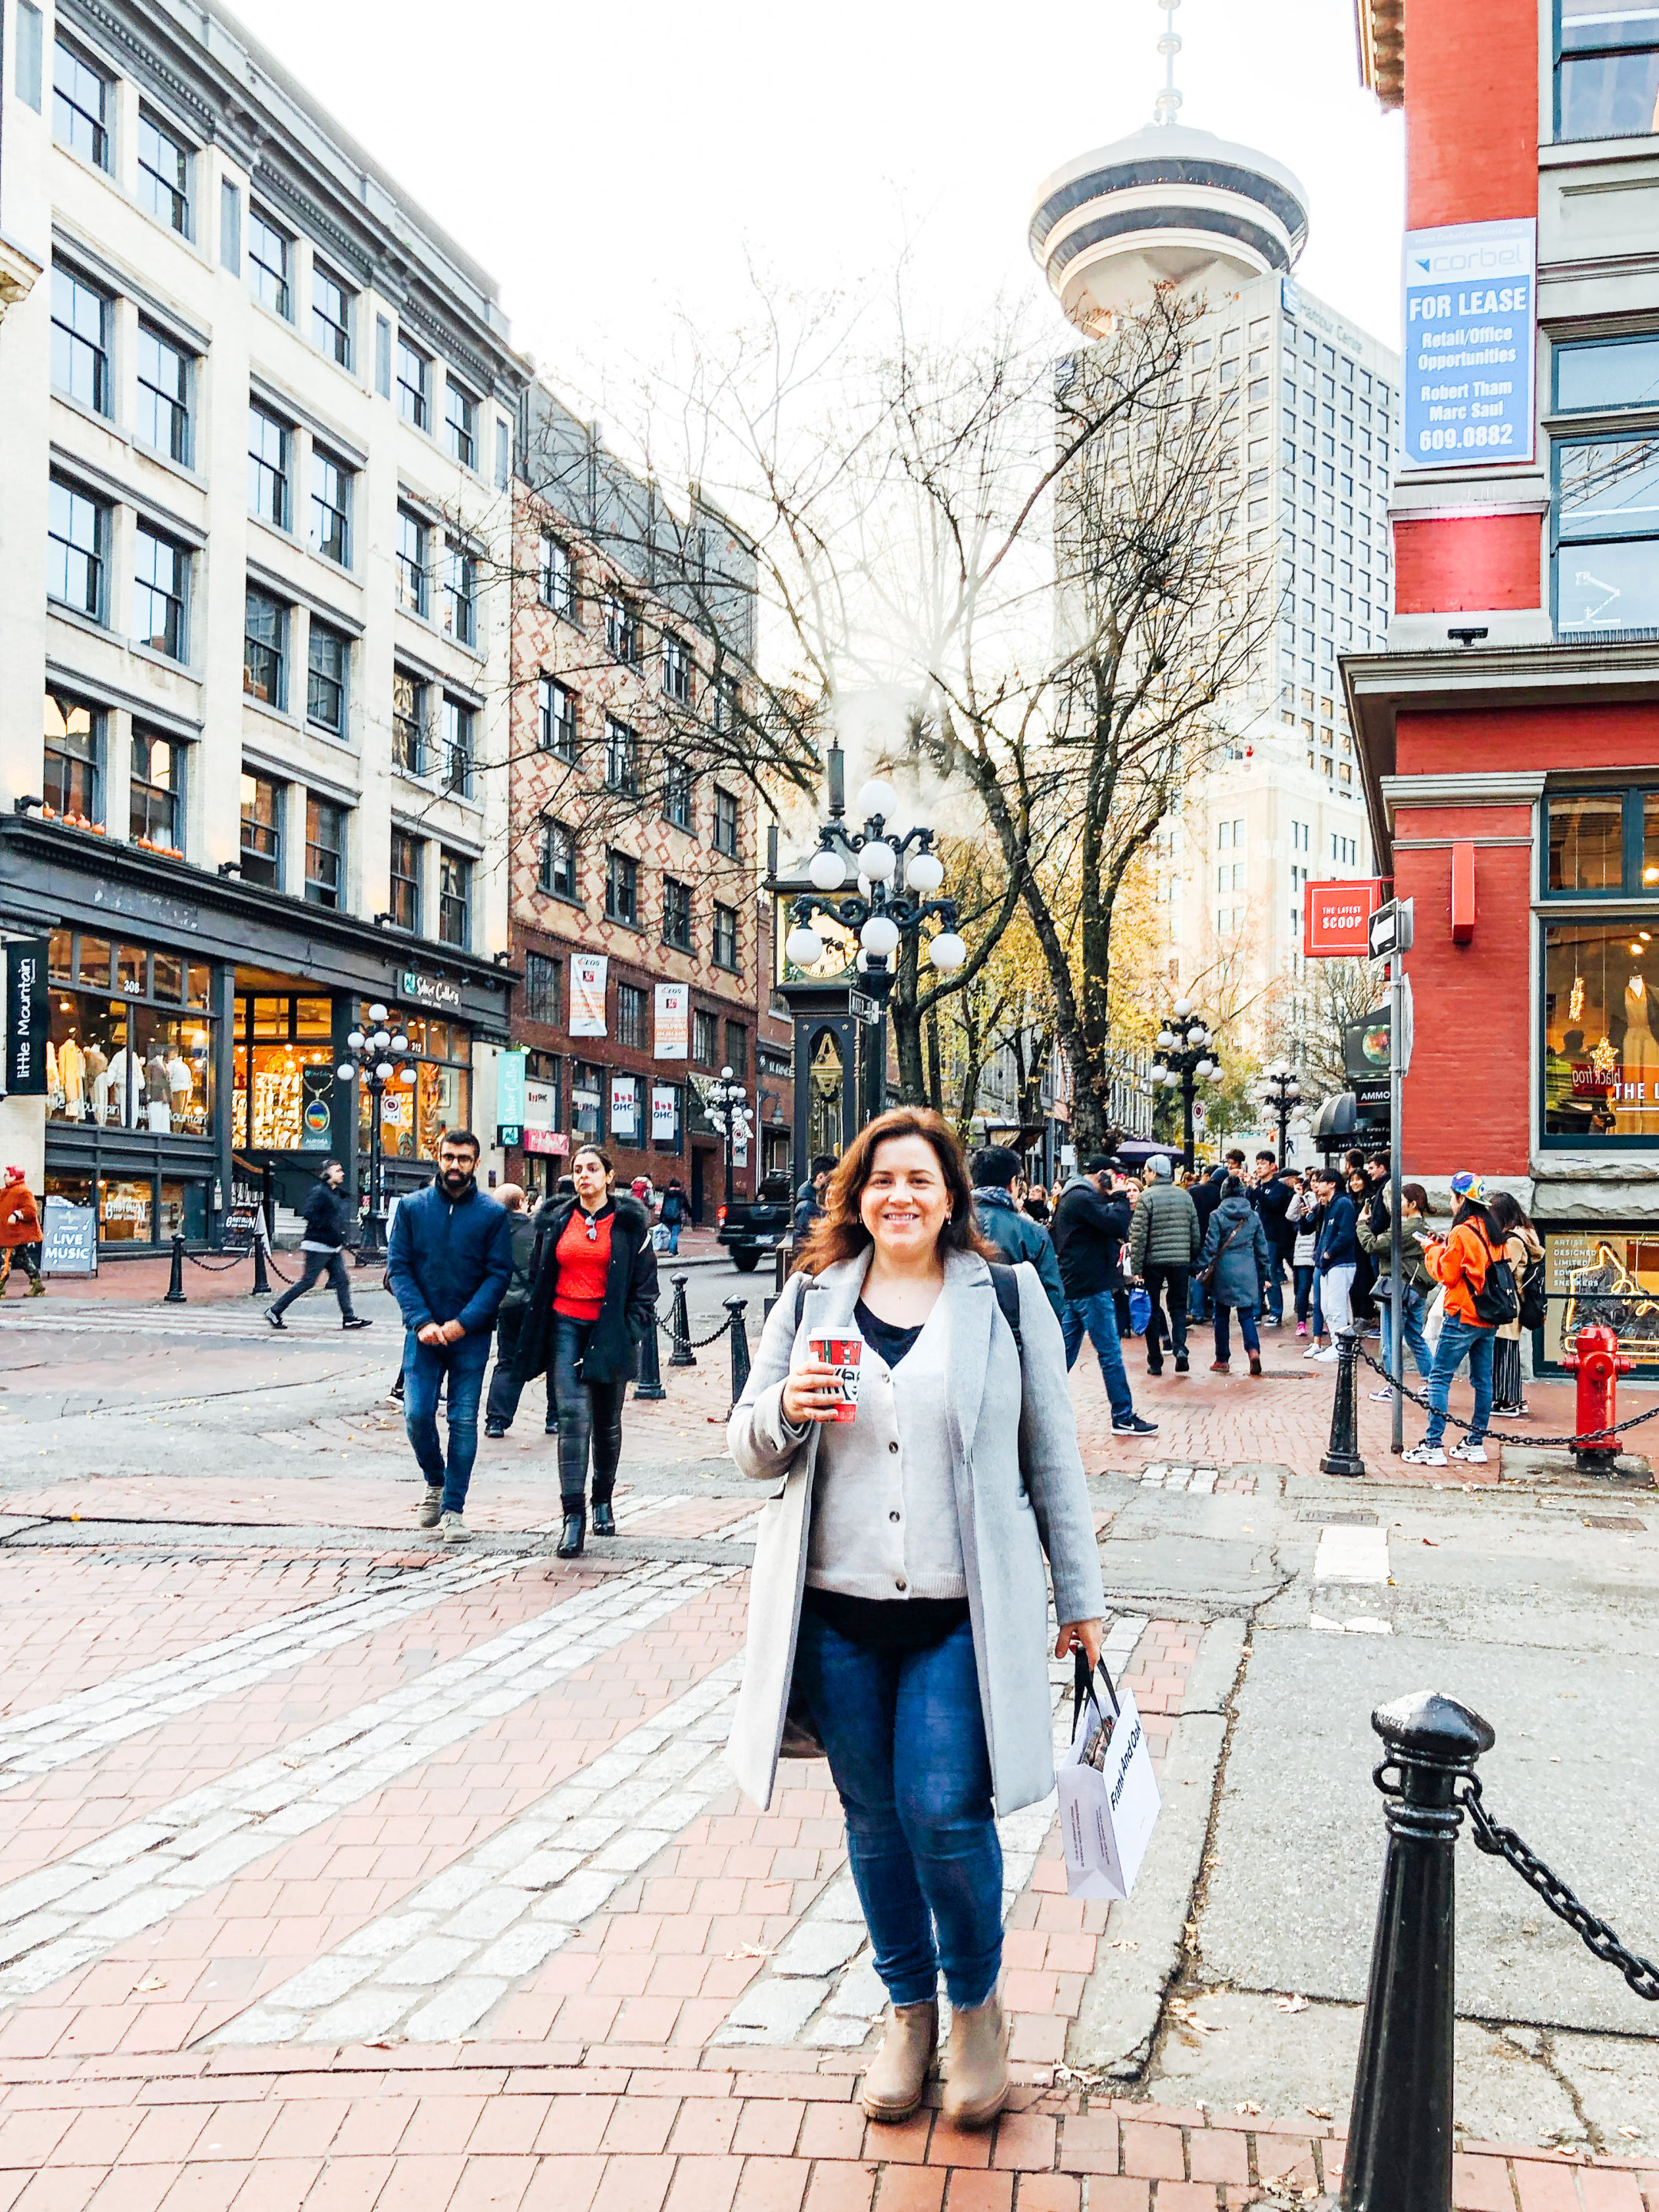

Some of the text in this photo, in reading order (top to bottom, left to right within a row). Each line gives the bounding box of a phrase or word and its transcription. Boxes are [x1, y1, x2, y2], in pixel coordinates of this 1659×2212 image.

[1433, 243, 1522, 272] corbel
[1409, 286, 1527, 322] FOR LEASE
[1422, 326, 1513, 349] Retail/Office
[1418, 347, 1517, 372] Opportunities
[1421, 380, 1512, 402] Robert Tham
[1429, 400, 1504, 422] Marc Saul
[1419, 423, 1513, 452] 609.0882
[1323, 906, 1361, 915] THE LATEST
[1322, 916, 1362, 929] SCOOP
[17, 959, 31, 1036] Mountain
[124, 979, 140, 994] 308
[1360, 1091, 1390, 1101] AMMO
[1613, 1082, 1645, 1100] THE
[53, 1233, 83, 1245] LIVE
[45, 1247, 90, 1260] MUSIC
[1111, 1719, 1141, 1812] Frank And Oak
